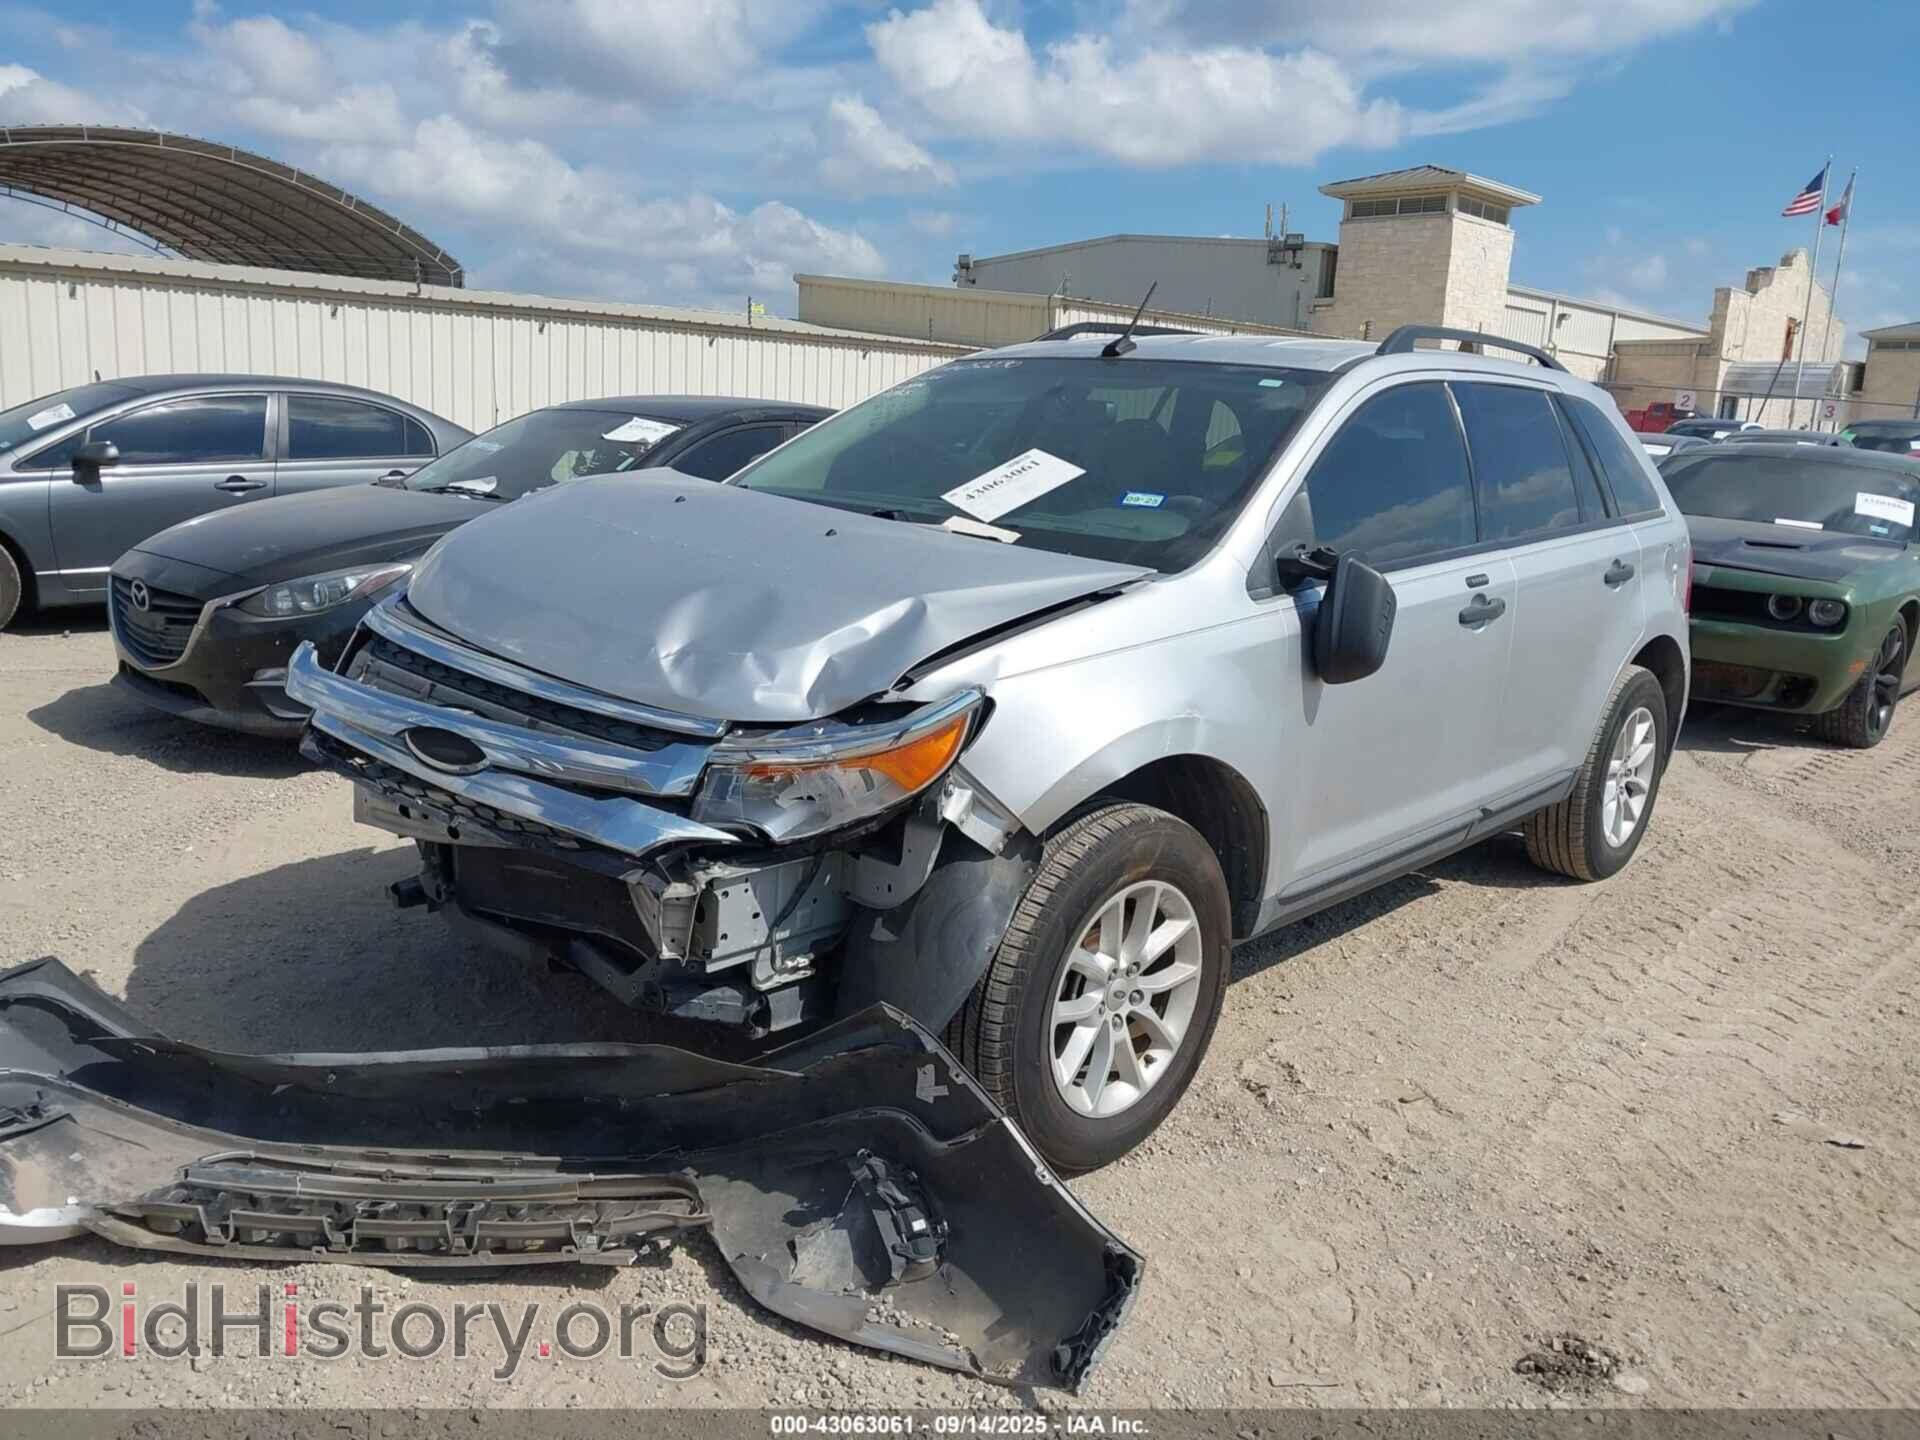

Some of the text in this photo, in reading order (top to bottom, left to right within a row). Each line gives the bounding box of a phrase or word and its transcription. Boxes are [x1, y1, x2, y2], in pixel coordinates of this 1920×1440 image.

[1680, 394, 1690, 407] 2
[1824, 405, 1836, 418] 3
[965, 459, 1041, 501] 43063061
